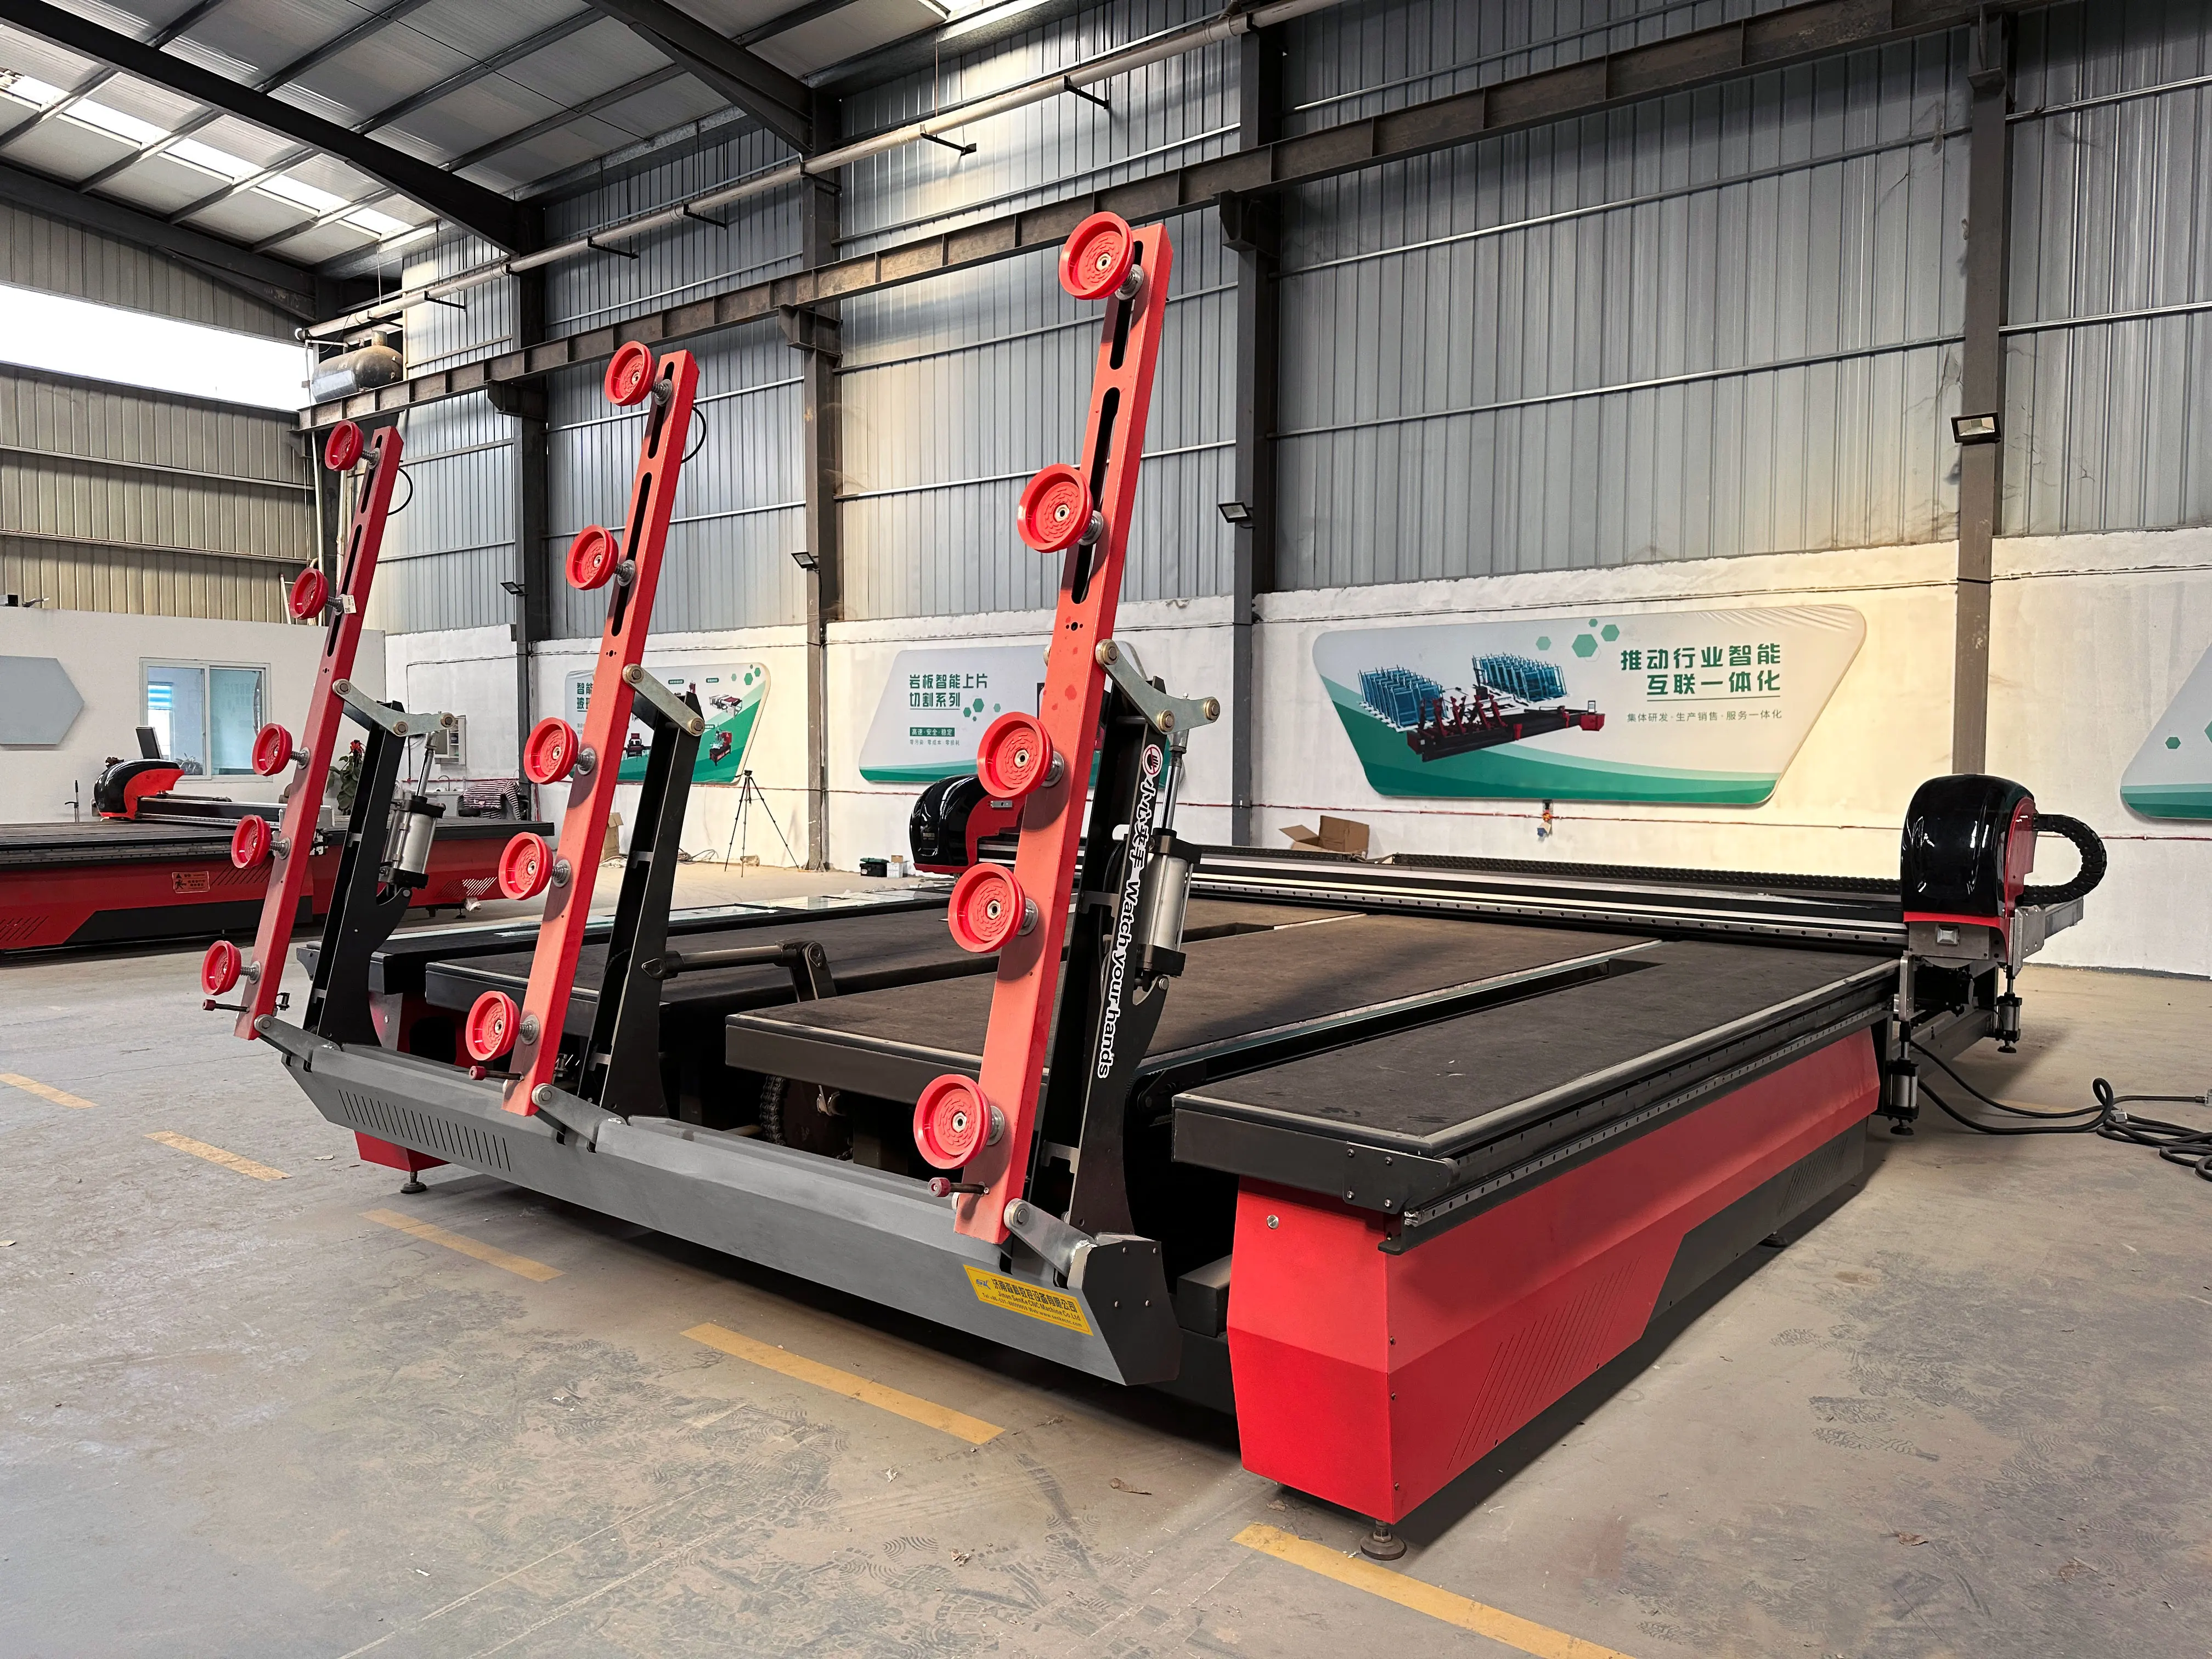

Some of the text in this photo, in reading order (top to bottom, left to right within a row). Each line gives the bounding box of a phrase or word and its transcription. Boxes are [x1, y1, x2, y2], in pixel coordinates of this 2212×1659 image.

[1621, 642, 1781, 671] 推动行业智能
[909, 673, 988, 689] 岩板智能上片
[1646, 669, 1781, 696] 互联一体化
[909, 692, 961, 708] 切割系列
[1130, 778, 1155, 868] 小心夹手
[1098, 881, 1139, 1077] Watch your hands
[997, 1290, 1013, 1300] Jinan
[1028, 1300, 1041, 1309] CNC
[1040, 1304, 1063, 1316] Machine
